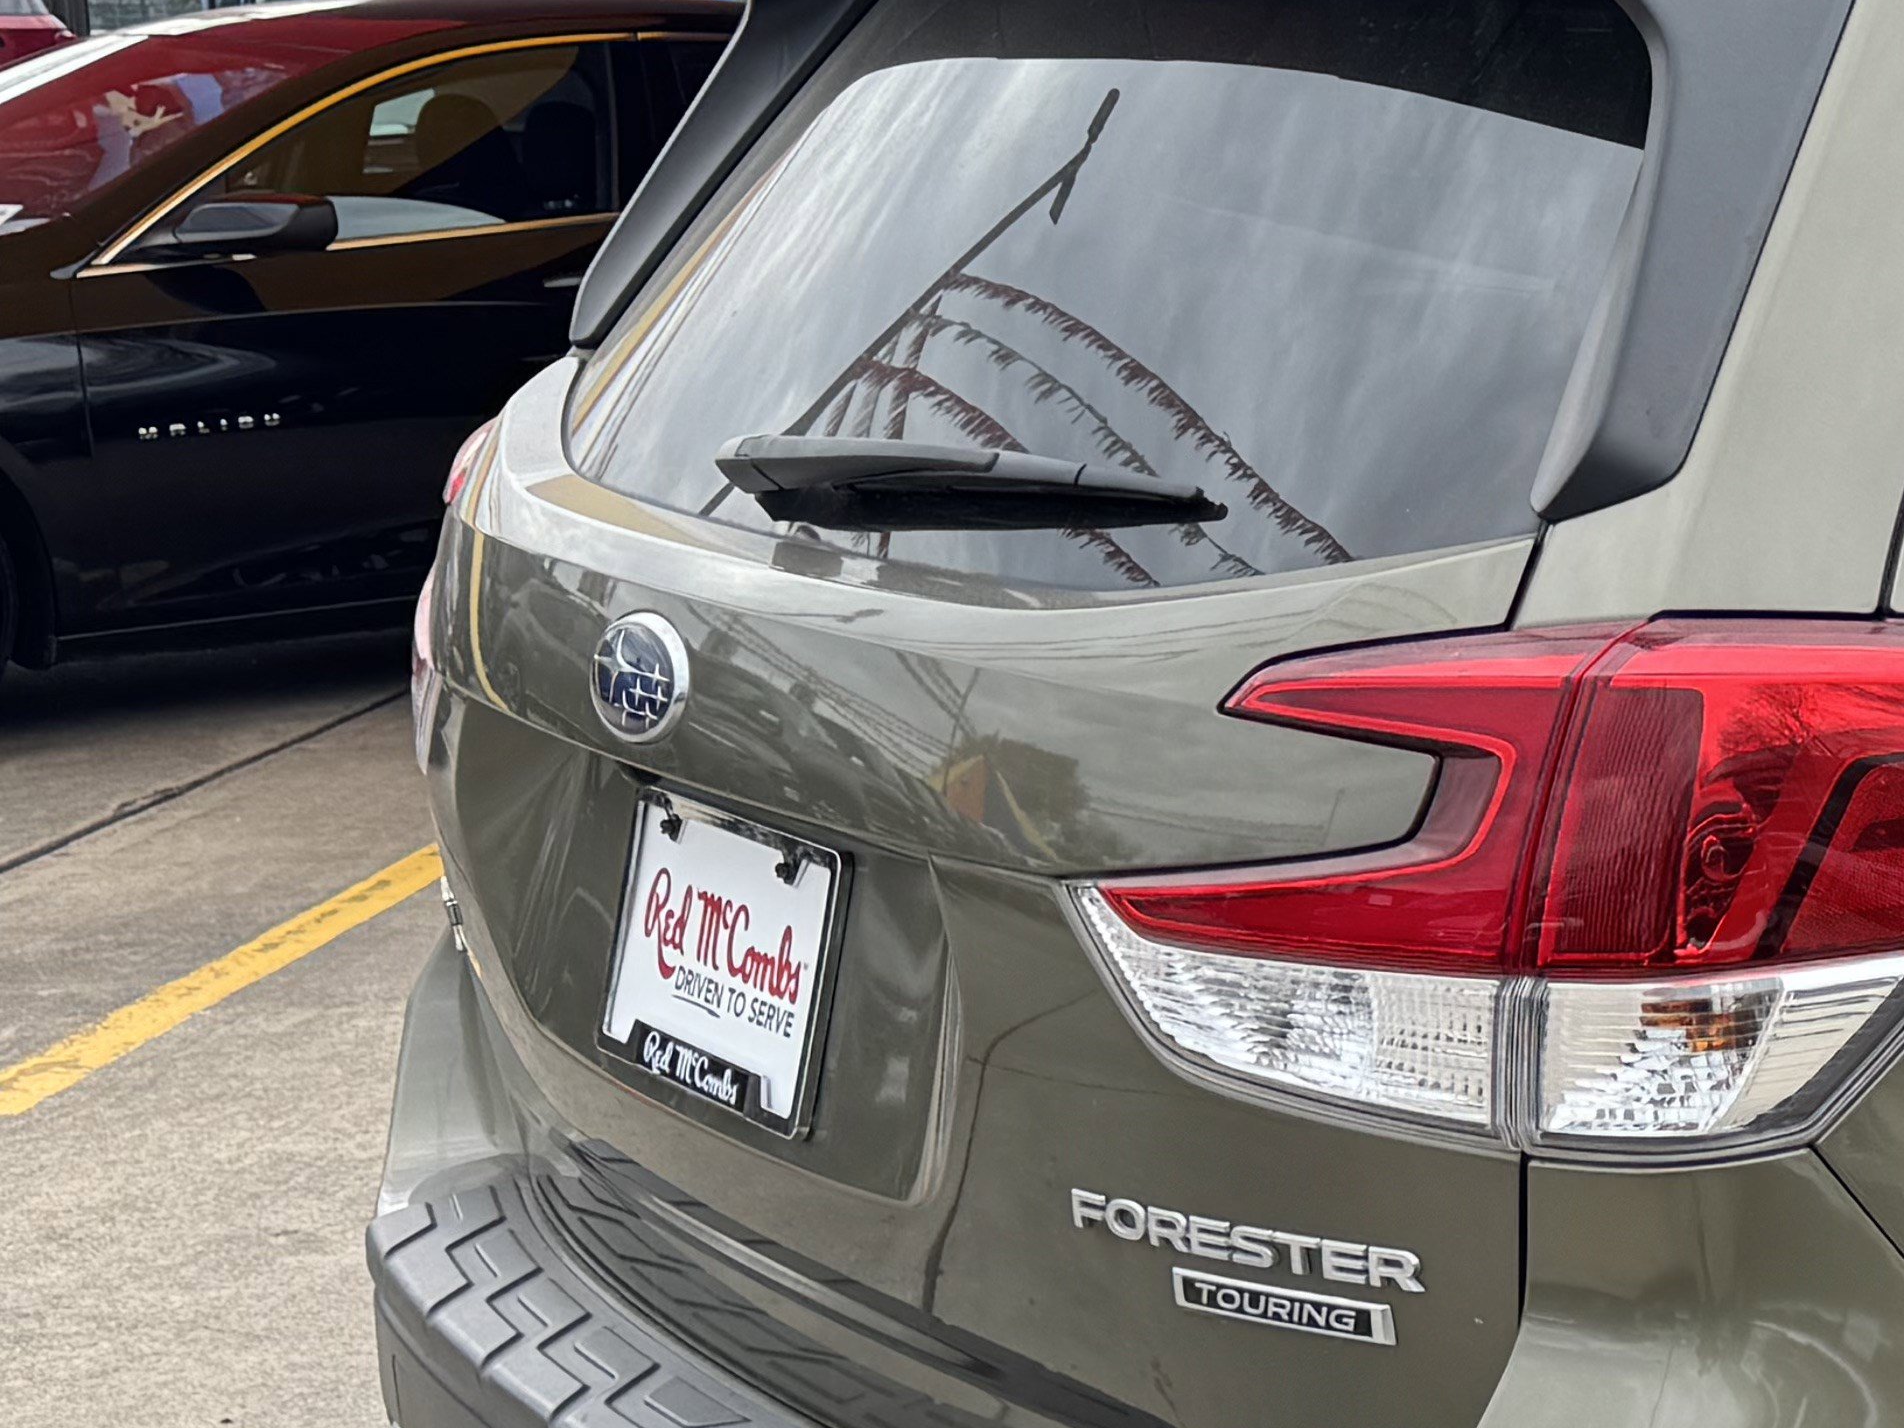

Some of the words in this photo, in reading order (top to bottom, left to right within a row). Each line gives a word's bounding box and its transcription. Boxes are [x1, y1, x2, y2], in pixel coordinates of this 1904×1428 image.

[138, 412, 281, 440] MALIBU
[645, 867, 693, 980] Red
[697, 886, 802, 1004] McCombs
[674, 965, 723, 1010] DRIVEN
[726, 987, 747, 1018] TO
[747, 996, 795, 1039] SERVE
[643, 1030, 674, 1075] Red
[675, 1044, 739, 1105] McCombs
[1071, 1188, 1426, 1293] FORESTER
[1194, 1282, 1357, 1332] TOURING
